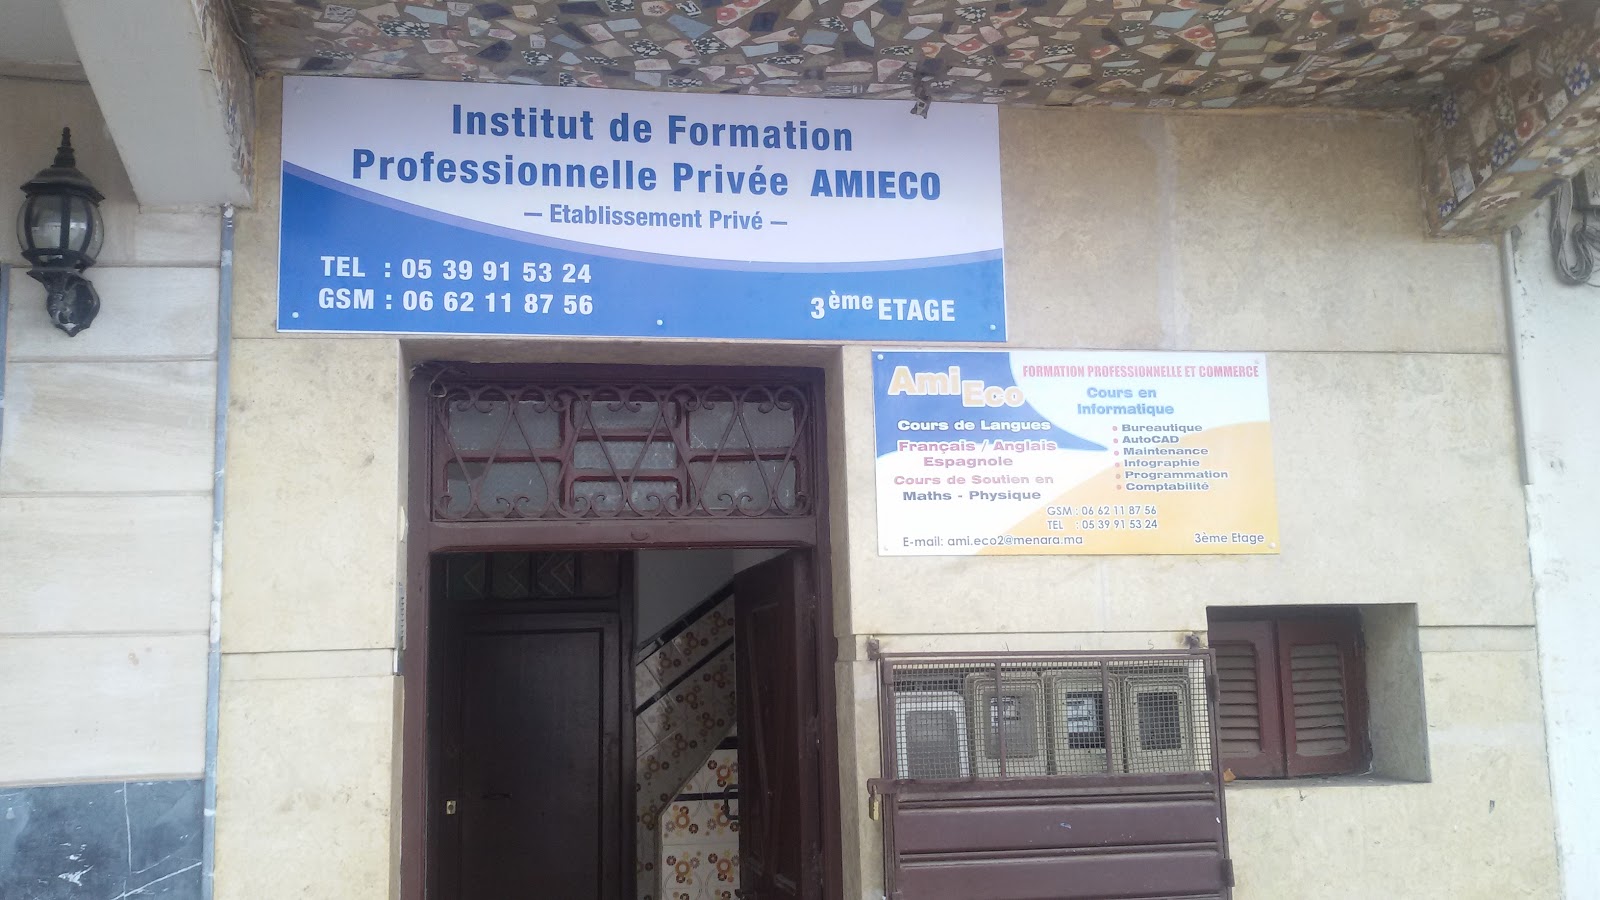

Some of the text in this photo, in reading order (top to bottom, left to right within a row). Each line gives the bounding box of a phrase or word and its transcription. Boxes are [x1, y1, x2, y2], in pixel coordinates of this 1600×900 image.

[452, 104, 852, 151] Institut de Formation
[353, 149, 941, 200] Professionnelle Privée AMIECO
[550, 204, 702, 229] Etablissement
[709, 210, 763, 230] Privé
[320, 256, 365, 277] TEL
[401, 258, 432, 280] 05
[443, 259, 473, 281] 39
[483, 261, 510, 282] 91
[523, 262, 552, 283] 53
[563, 264, 592, 284] 24
[318, 288, 374, 309] GSM
[402, 290, 433, 312] 06
[443, 291, 474, 312] 62
[485, 292, 511, 313] 11
[524, 293, 554, 314] 87
[564, 294, 594, 315] 56
[810, 290, 955, 322] 3ème ETAGE
[1022, 365, 1259, 378] FORMATION PROFESSIONNELLE ET COMMERCE
[1087, 387, 1157, 399] Cours en
[1077, 403, 1175, 416] Informatique
[897, 420, 1051, 432] Cours de Langues
[1121, 424, 1203, 434] Bureautique
[1122, 435, 1180, 444] AutoCAD
[898, 440, 976, 454] Français
[993, 439, 1057, 453] Anglais
[1123, 447, 1209, 456] Maintenance
[923, 457, 1013, 468] Espagnole
[1124, 458, 1200, 469] Infographie
[894, 475, 1054, 485] Cours de Soutien en
[1125, 470, 1229, 481] Programmation
[1125, 481, 1210, 493] Comptabilité
[902, 491, 952, 501] Maths
[969, 490, 1042, 501] Physique
[1047, 506, 1073, 516] GSM
[1081, 506, 1094, 516] 06
[1097, 506, 1110, 516] 62
[1114, 506, 1125, 515] 11
[1128, 506, 1141, 515] 87
[1144, 505, 1157, 515] 56
[1047, 520, 1063, 530] TEL
[1082, 520, 1095, 530] 05
[1098, 520, 1110, 530] 39
[1114, 520, 1125, 529] 91
[1129, 520, 1142, 529] 53
[1145, 519, 1158, 529] 24
[903, 534, 1083, 547] E-mail: ami.eco2@menara.ma
[1194, 532, 1265, 545] 3ème Etage
